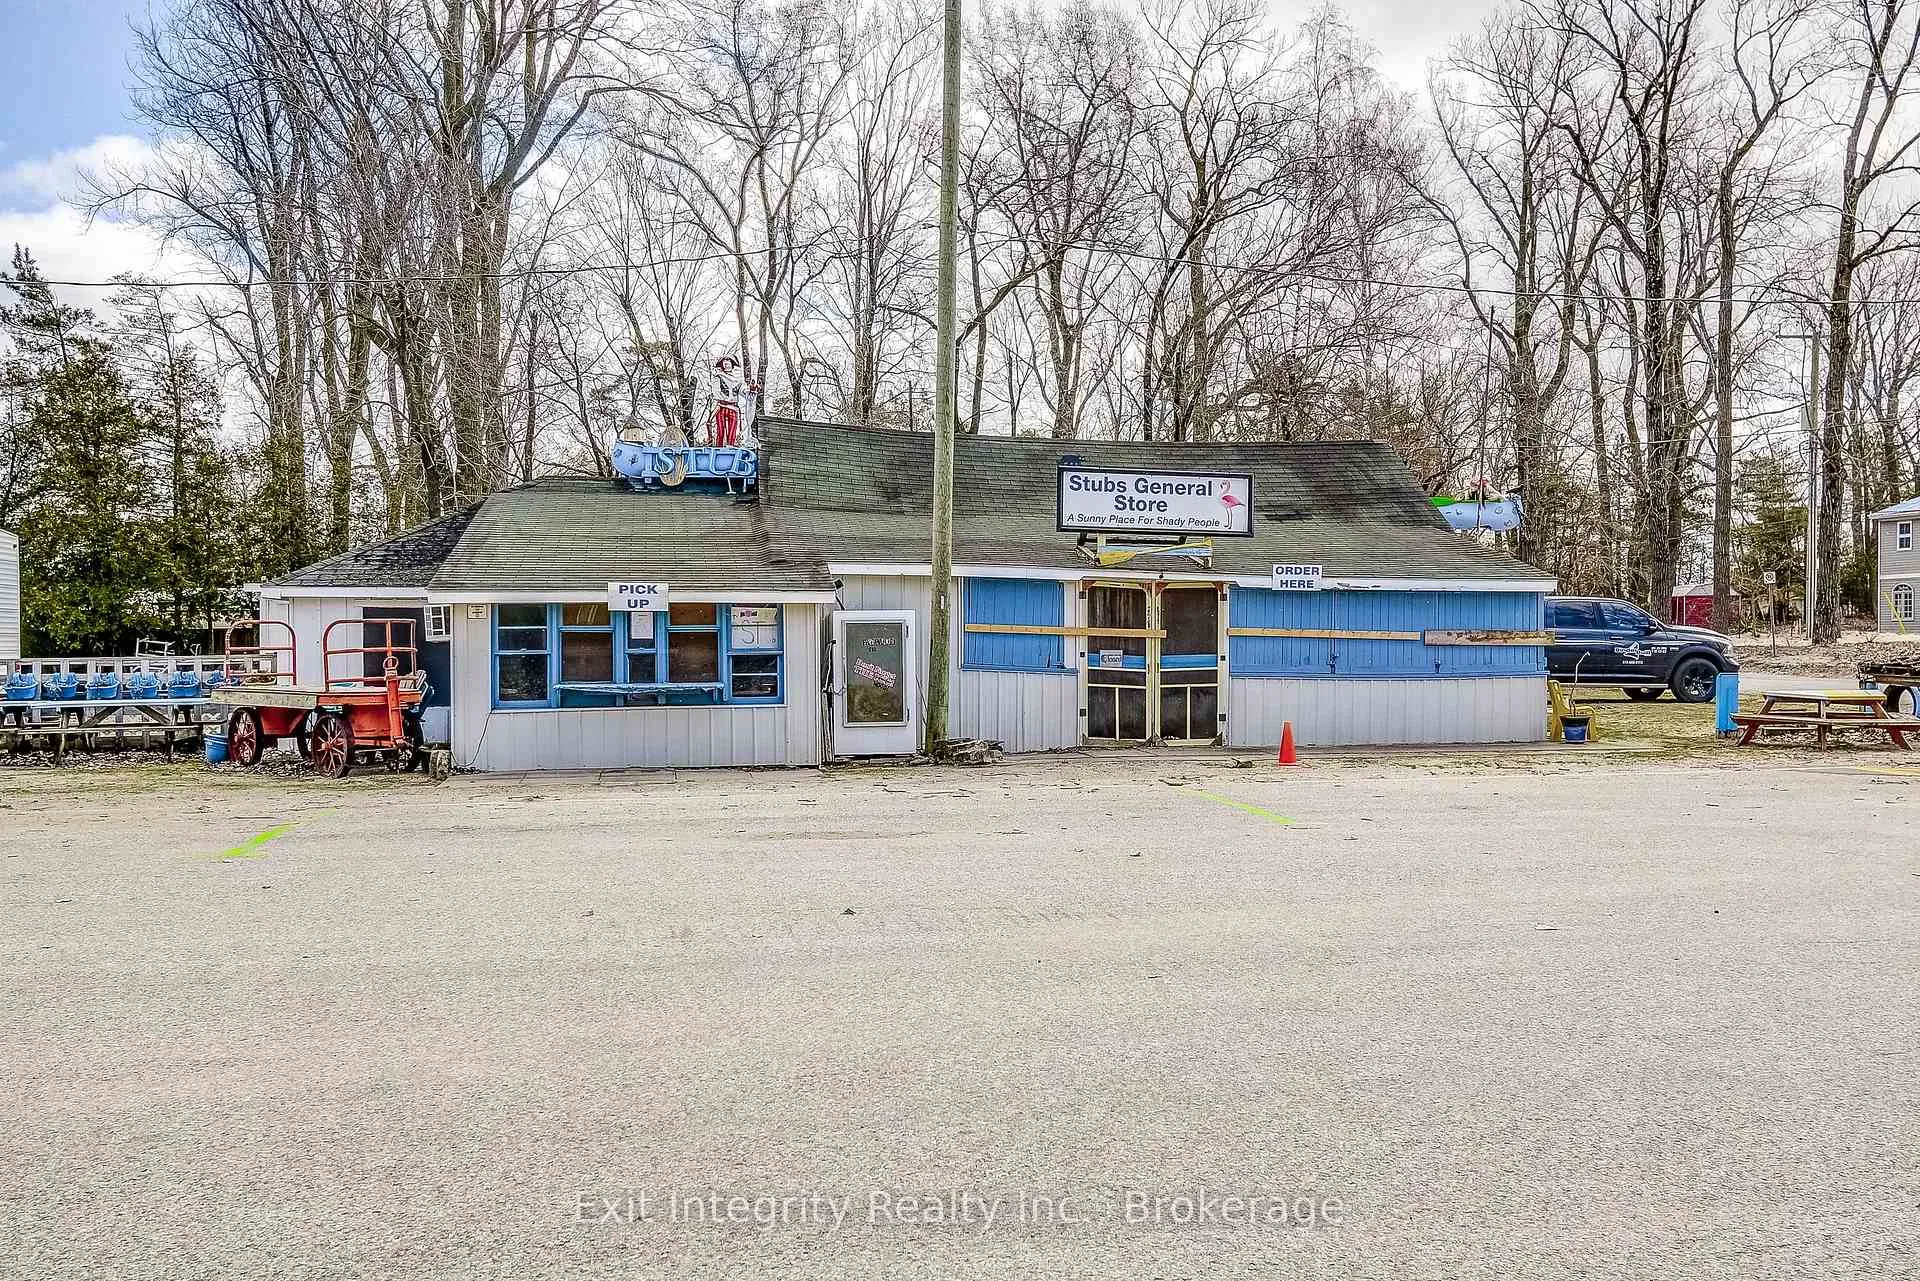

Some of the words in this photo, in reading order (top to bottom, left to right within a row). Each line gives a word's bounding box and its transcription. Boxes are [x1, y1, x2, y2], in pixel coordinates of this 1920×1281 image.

[1069, 475, 1127, 493] Stubs
[1134, 478, 1213, 497] General
[1113, 495, 1168, 513] Store
[1067, 513, 1075, 522] A
[1077, 513, 1106, 525] Sunny
[1108, 515, 1135, 525] Place
[1137, 516, 1155, 525] For
[1157, 516, 1185, 527] Shady
[1187, 517, 1220, 528] People
[1275, 566, 1320, 576] ORDER
[618, 584, 658, 595] PICK
[1280, 579, 1315, 589] HERE
[627, 599, 650, 609] UP
